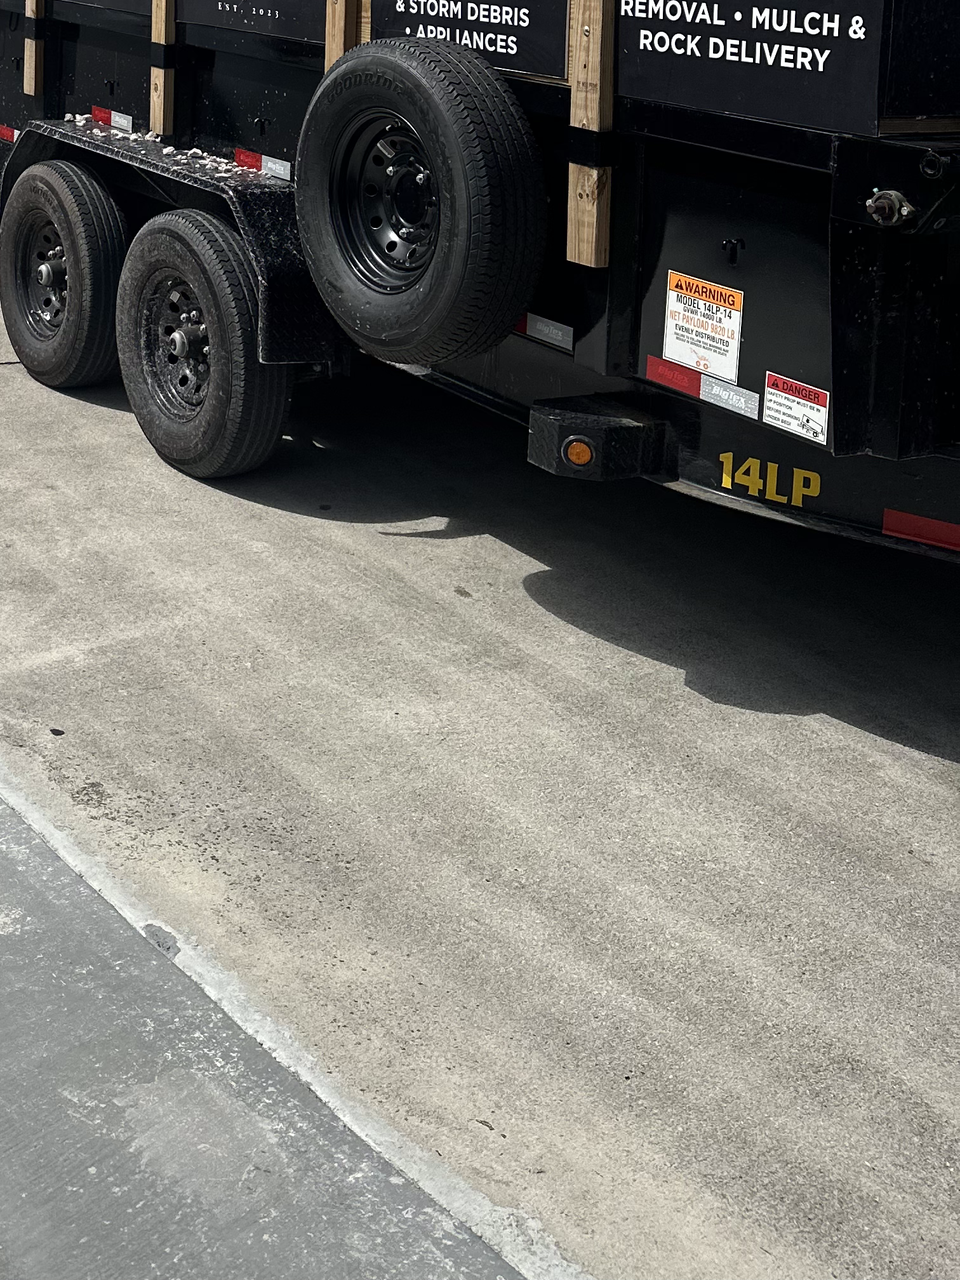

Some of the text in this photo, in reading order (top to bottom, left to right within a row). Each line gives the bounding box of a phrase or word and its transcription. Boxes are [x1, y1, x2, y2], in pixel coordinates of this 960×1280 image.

[252, 7, 279, 19] 2023
[467, 2, 530, 27] DEBRIS
[751, 7, 841, 37] MULCH
[848, 15, 866, 40] &
[639, 29, 831, 72] ROCK DELIVERY
[684, 280, 736, 307] WARNING
[676, 294, 732, 320] MODEL 14LP-14
[683, 306, 699, 317] GVWR
[700, 310, 715, 322] 14000
[670, 310, 681, 321] NET
[682, 313, 709, 332] PAYLOAD
[710, 321, 726, 337] 9820
[675, 323, 694, 335] EVENLY
[695, 330, 730, 348] DISTRIBUTED
[712, 385, 746, 408] BigTex
[767, 390, 784, 400] SAFETY
[796, 400, 809, 408] MUST
[782, 380, 820, 403] DANGER
[773, 399, 793, 411] POSITION
[719, 452, 821, 507] 14LP
